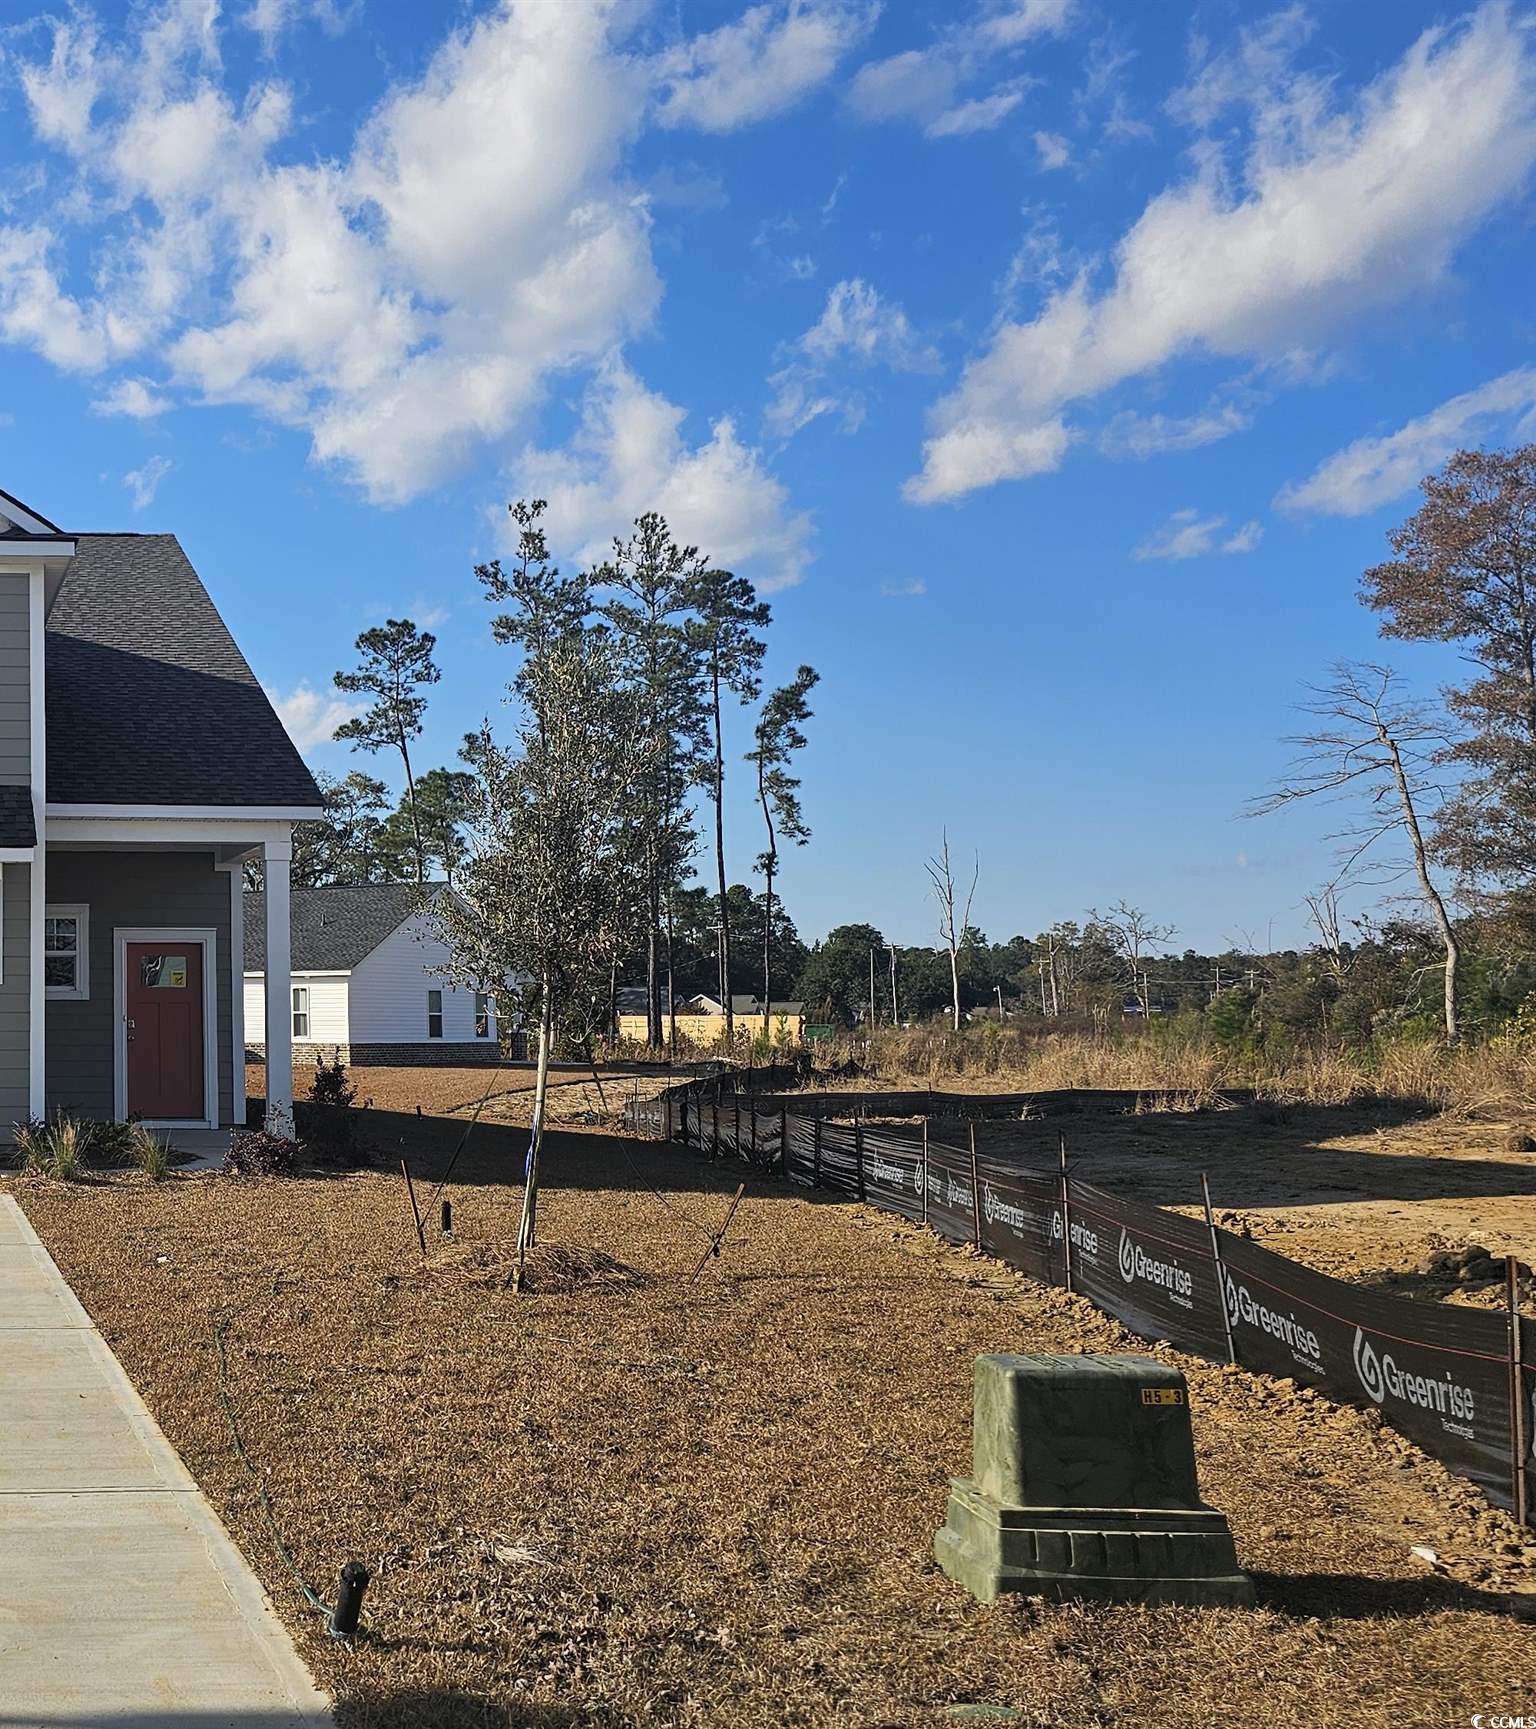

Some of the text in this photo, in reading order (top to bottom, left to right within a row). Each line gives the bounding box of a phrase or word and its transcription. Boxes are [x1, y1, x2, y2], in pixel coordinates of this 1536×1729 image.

[1135, 1245, 1192, 1296] Greenrise
[1238, 1285, 1321, 1359] Greenrise
[1382, 1354, 1475, 1421] Greenrise
